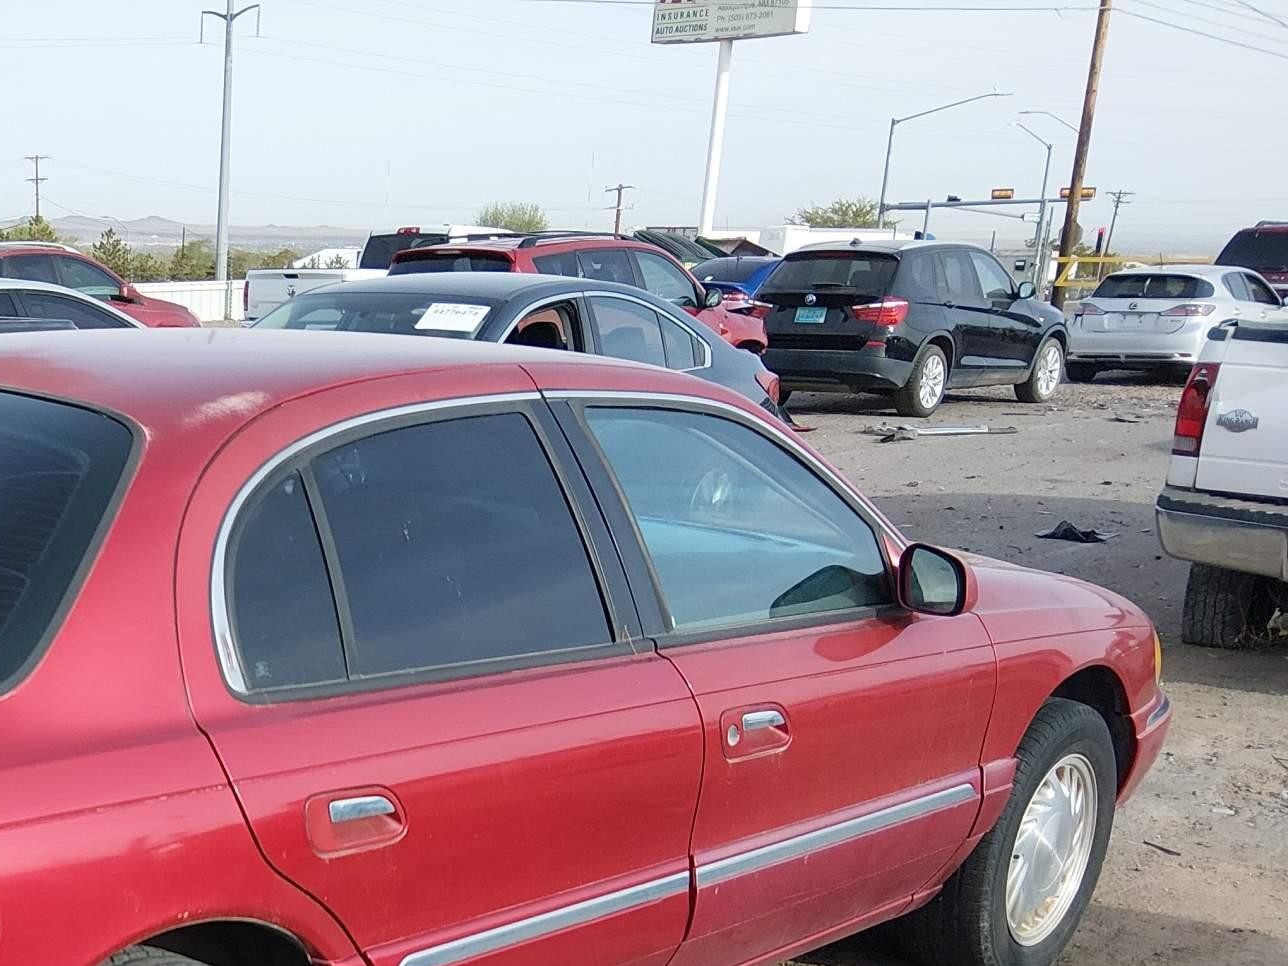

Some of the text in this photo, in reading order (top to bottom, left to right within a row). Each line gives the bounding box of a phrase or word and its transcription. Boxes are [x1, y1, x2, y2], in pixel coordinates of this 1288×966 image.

[657, 9, 710, 21] INSURANCE
[656, 23, 709, 35] AUTO AUCTIONS
